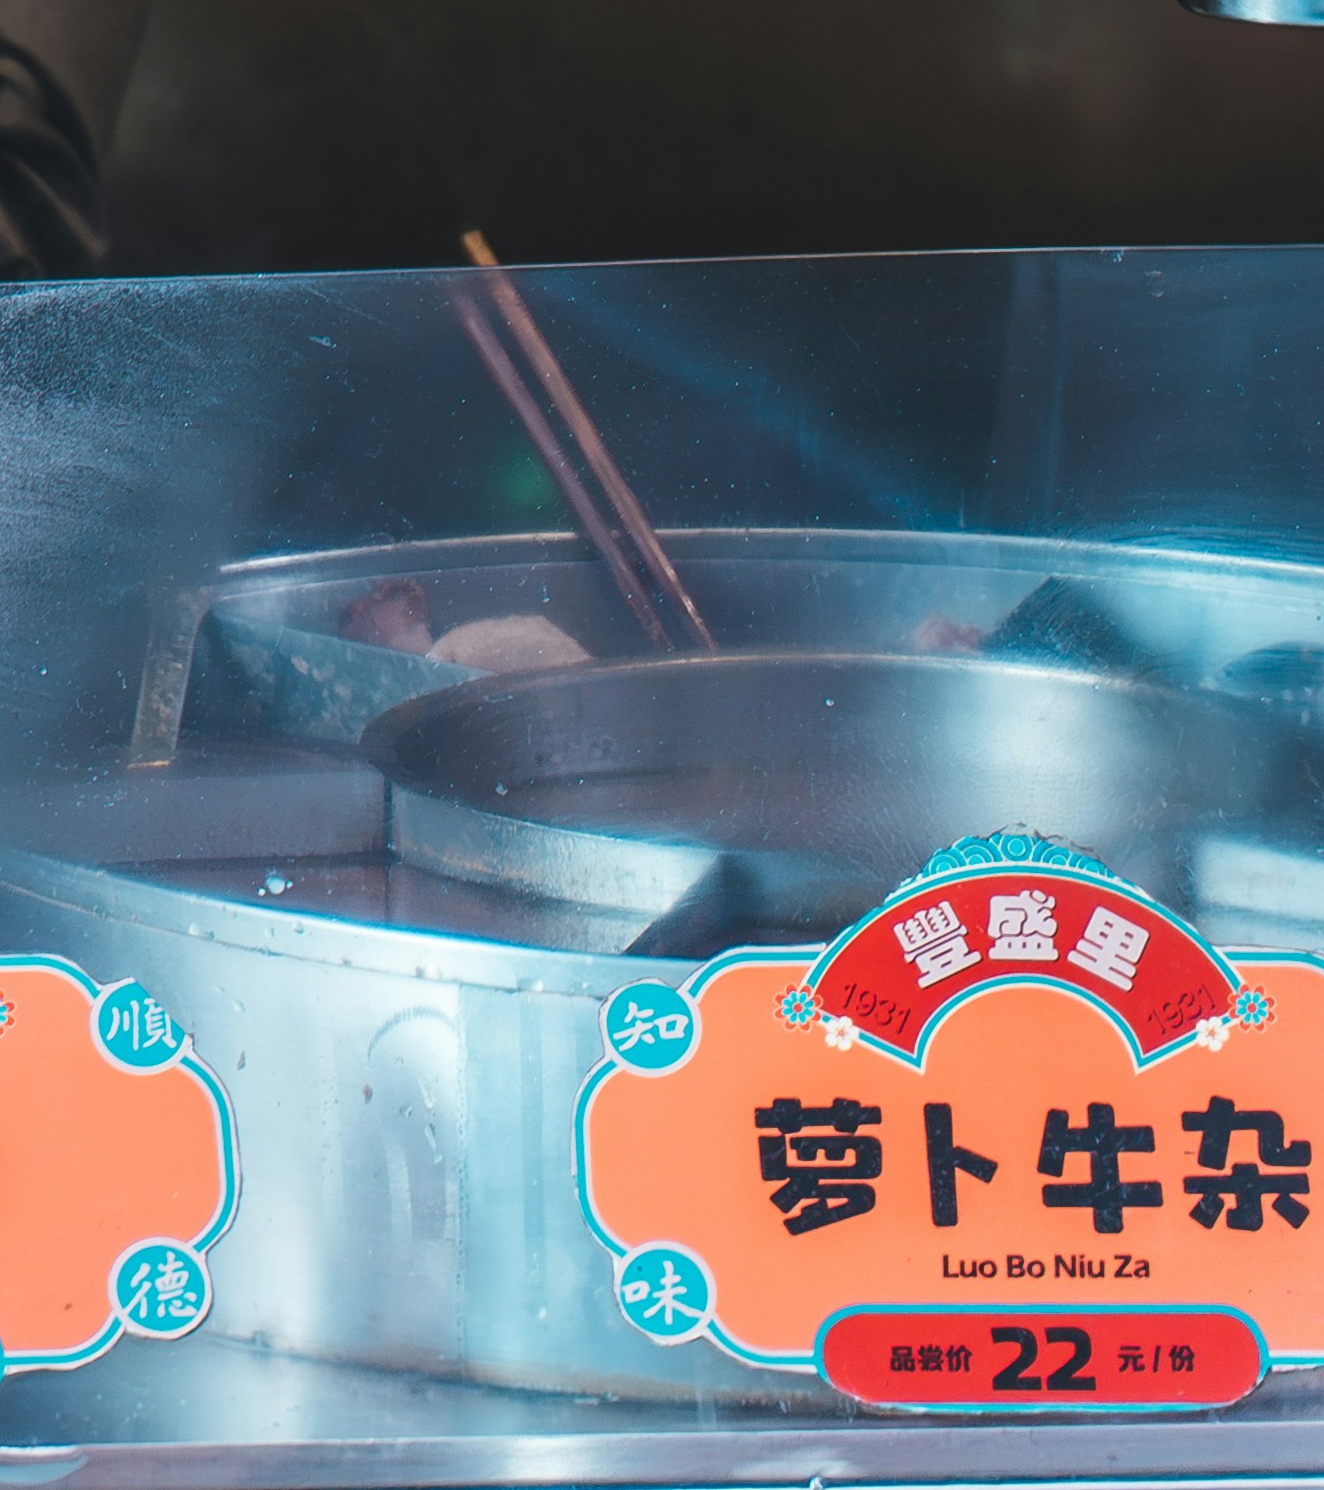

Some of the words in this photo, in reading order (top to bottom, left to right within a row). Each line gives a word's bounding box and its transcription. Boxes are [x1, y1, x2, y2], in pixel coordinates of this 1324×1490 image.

[893, 889, 1150, 992] 豐盛里
[108, 999, 183, 1052] 順
[613, 1002, 688, 1053] 知
[754, 1096, 1312, 1236] 萝卜牛杂
[127, 1259, 197, 1319] 德
[622, 1261, 703, 1325] 味
[942, 1255, 998, 1279] Luo
[1006, 1255, 1046, 1279] Bo
[1054, 1255, 1105, 1279] Niu
[1114, 1255, 1150, 1278] Za
[890, 1345, 972, 1373] 品尝价
[989, 1326, 1097, 1392] 22
[1118, 1345, 1194, 1373] 元/份
